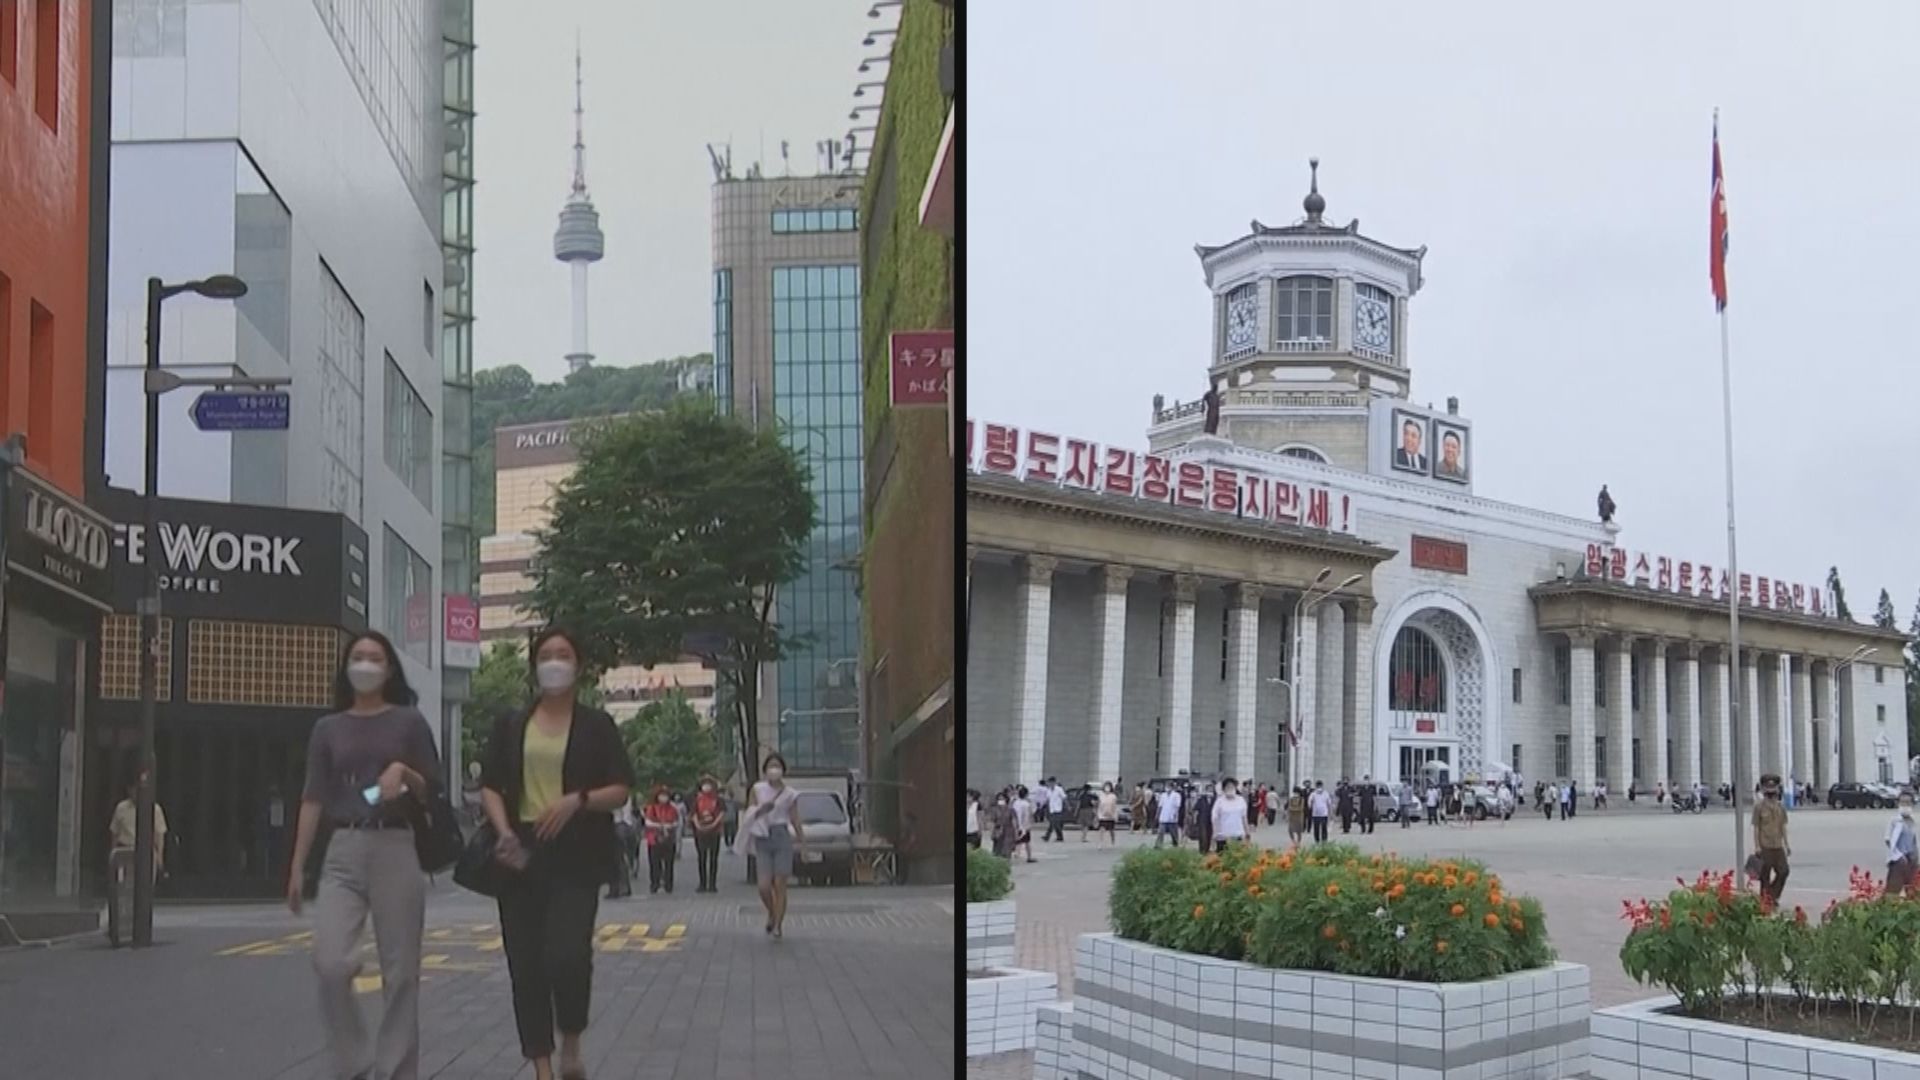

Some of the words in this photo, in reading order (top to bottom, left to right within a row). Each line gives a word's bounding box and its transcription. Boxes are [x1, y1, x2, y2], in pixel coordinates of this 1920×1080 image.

[27, 489, 108, 569] LLOYD
[158, 522, 301, 575] WORK
[159, 575, 220, 593] OFFEE
